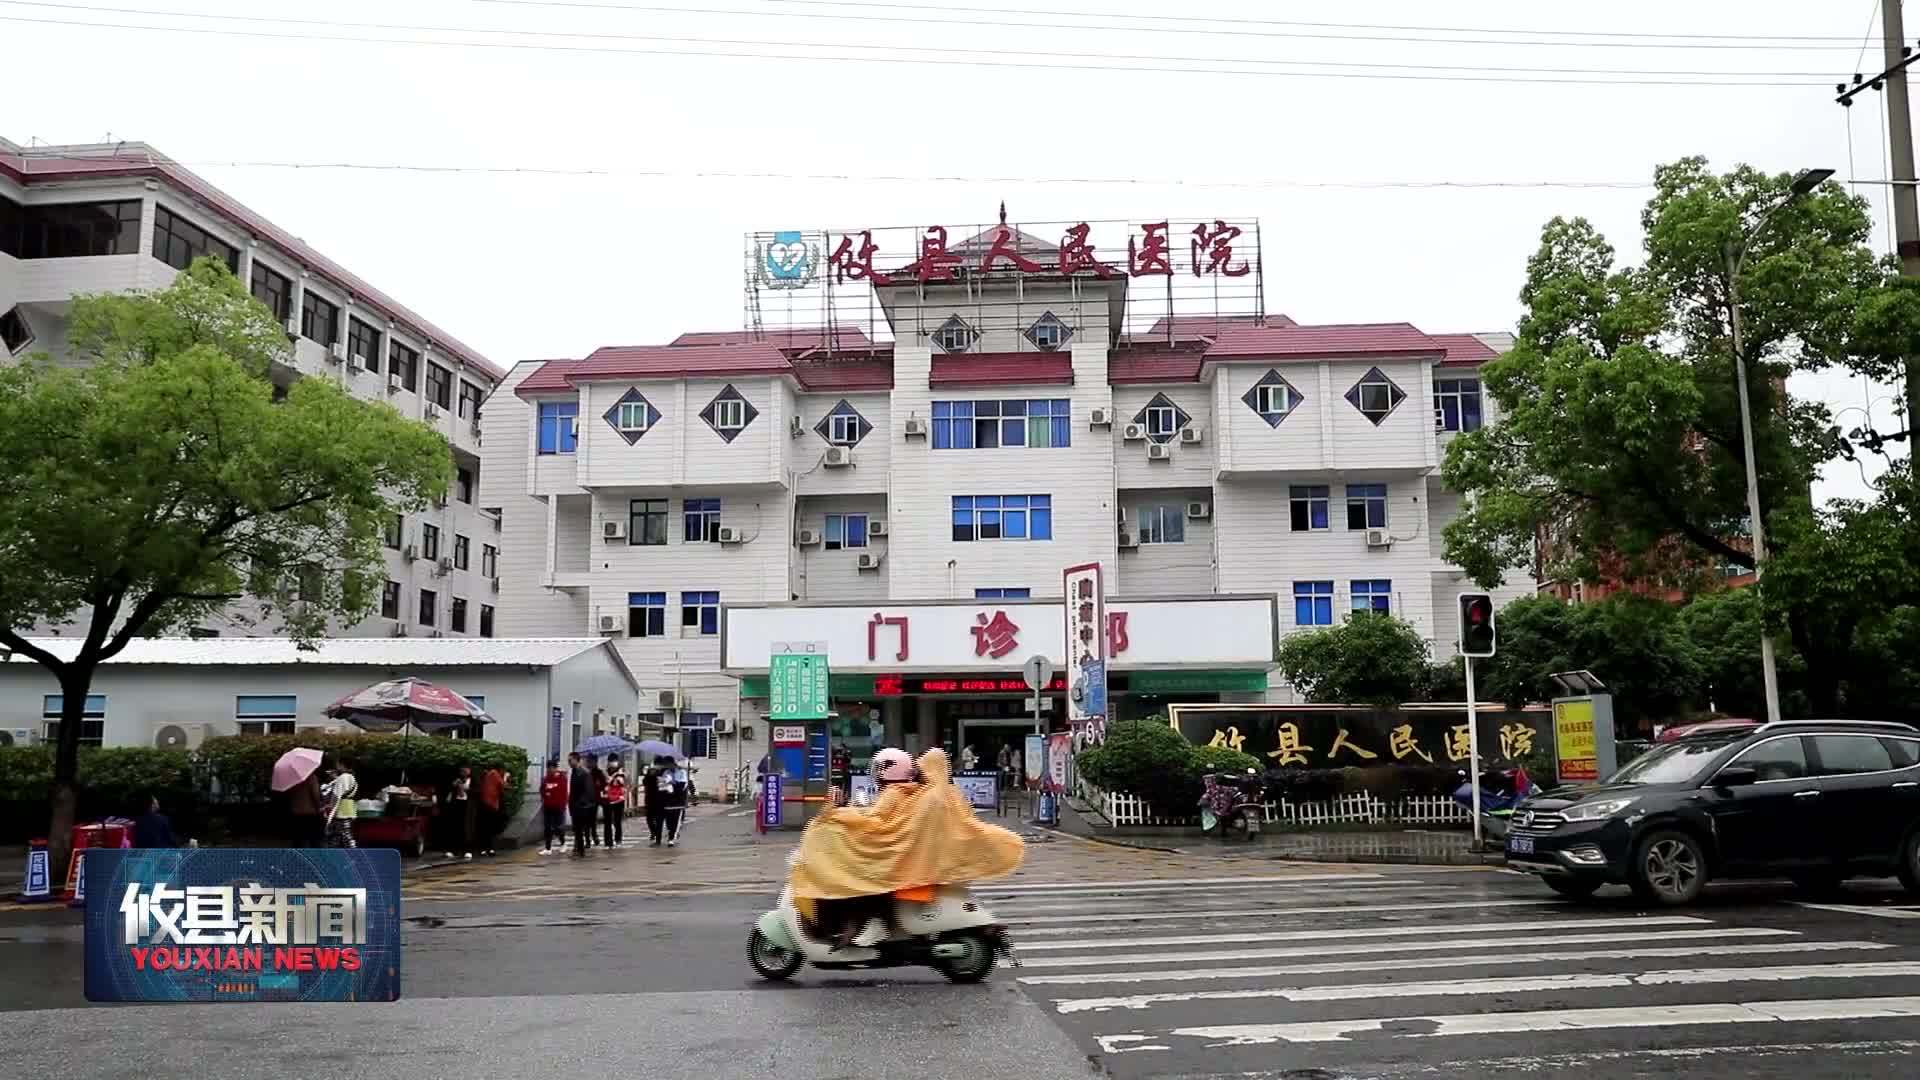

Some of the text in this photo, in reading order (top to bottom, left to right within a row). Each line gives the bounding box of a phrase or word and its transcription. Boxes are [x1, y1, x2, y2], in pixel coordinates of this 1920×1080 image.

[830, 221, 1250, 286] 攸县人民医院
